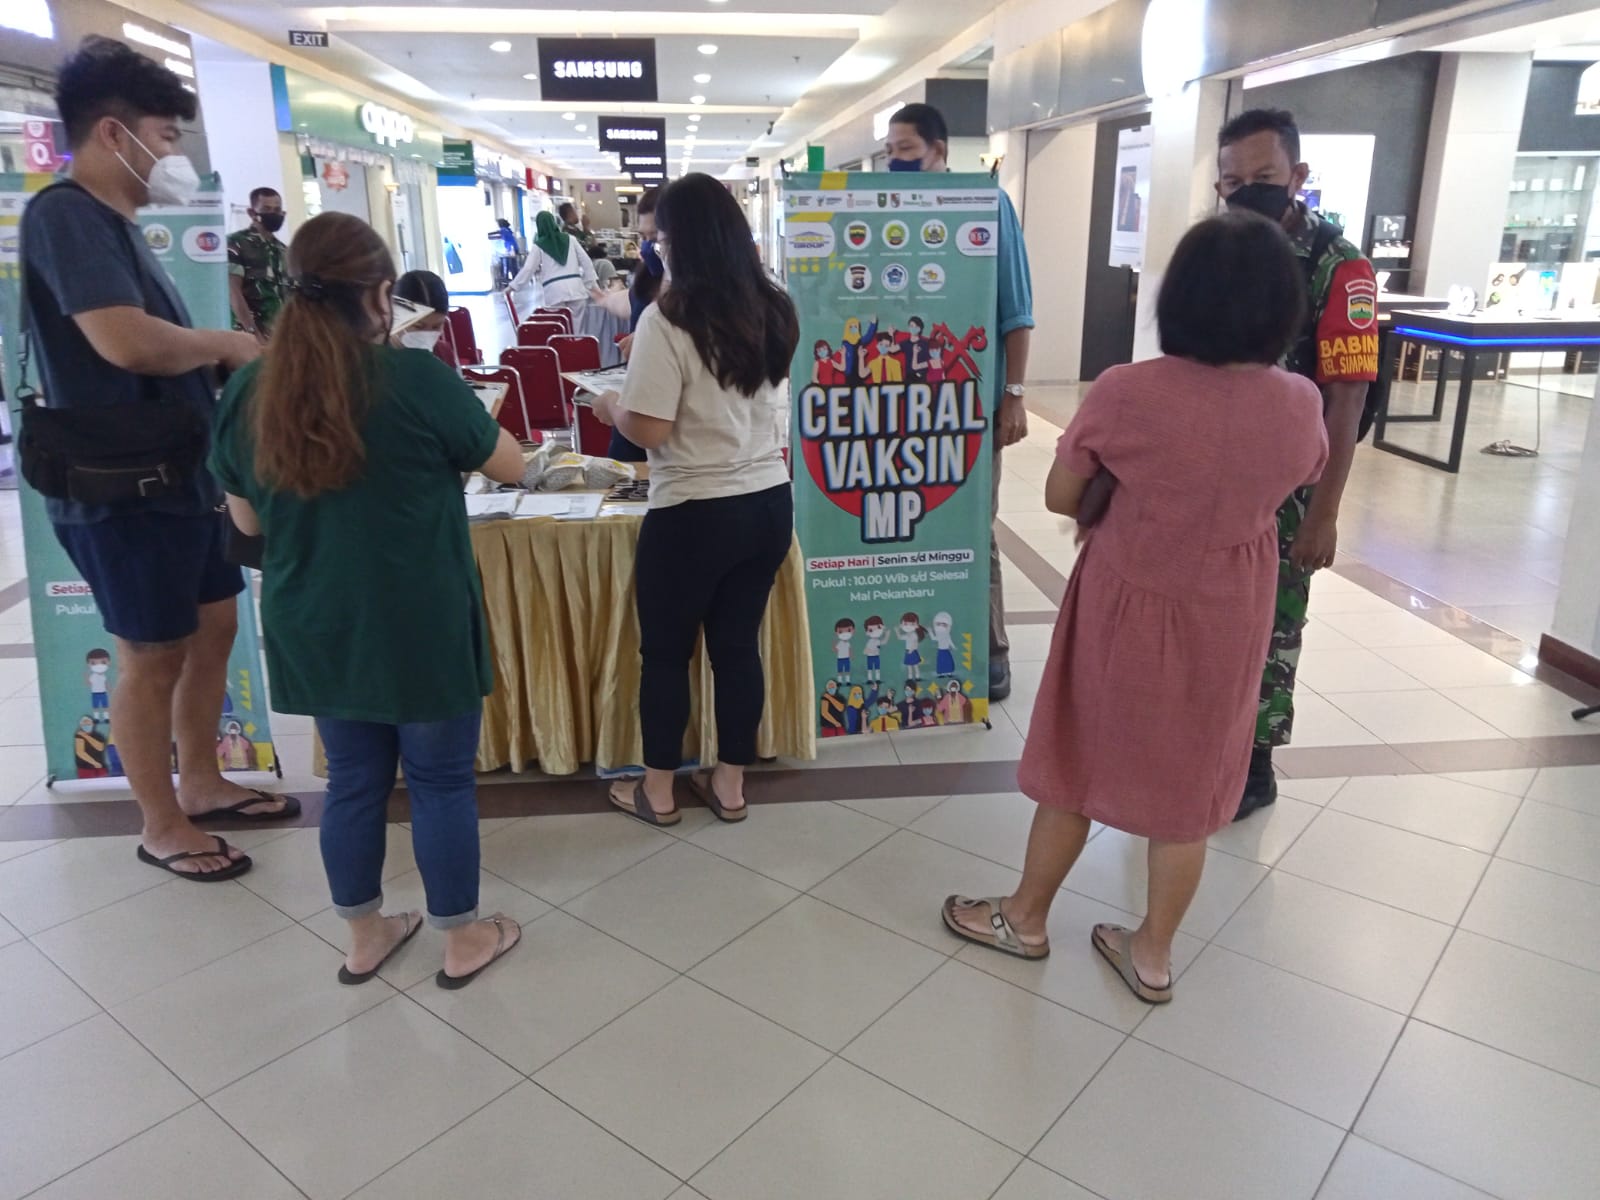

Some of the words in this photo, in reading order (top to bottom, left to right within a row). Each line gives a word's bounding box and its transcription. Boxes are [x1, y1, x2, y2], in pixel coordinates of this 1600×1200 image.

[293, 33, 323, 46] EXIT
[553, 60, 643, 78] SAMSUNG
[801, 380, 986, 438] CENTRAL
[822, 434, 966, 490] VAKSIN
[863, 490, 923, 540] MP
[810, 559, 845, 571] Setiap
[847, 556, 870, 568] Hari
[877, 556, 908, 566] Senin
[911, 552, 926, 563] s/d
[928, 551, 970, 563] Minggu
[812, 577, 846, 589] Pukul
[853, 575, 883, 586] 10.00
[885, 573, 909, 584] Wib
[911, 571, 927, 583] s/d
[929, 569, 969, 581] Selesai
[850, 591, 871, 602] Mal
[873, 588, 935, 600] Pekanbaru
[56, 603, 97, 615] Pukul
